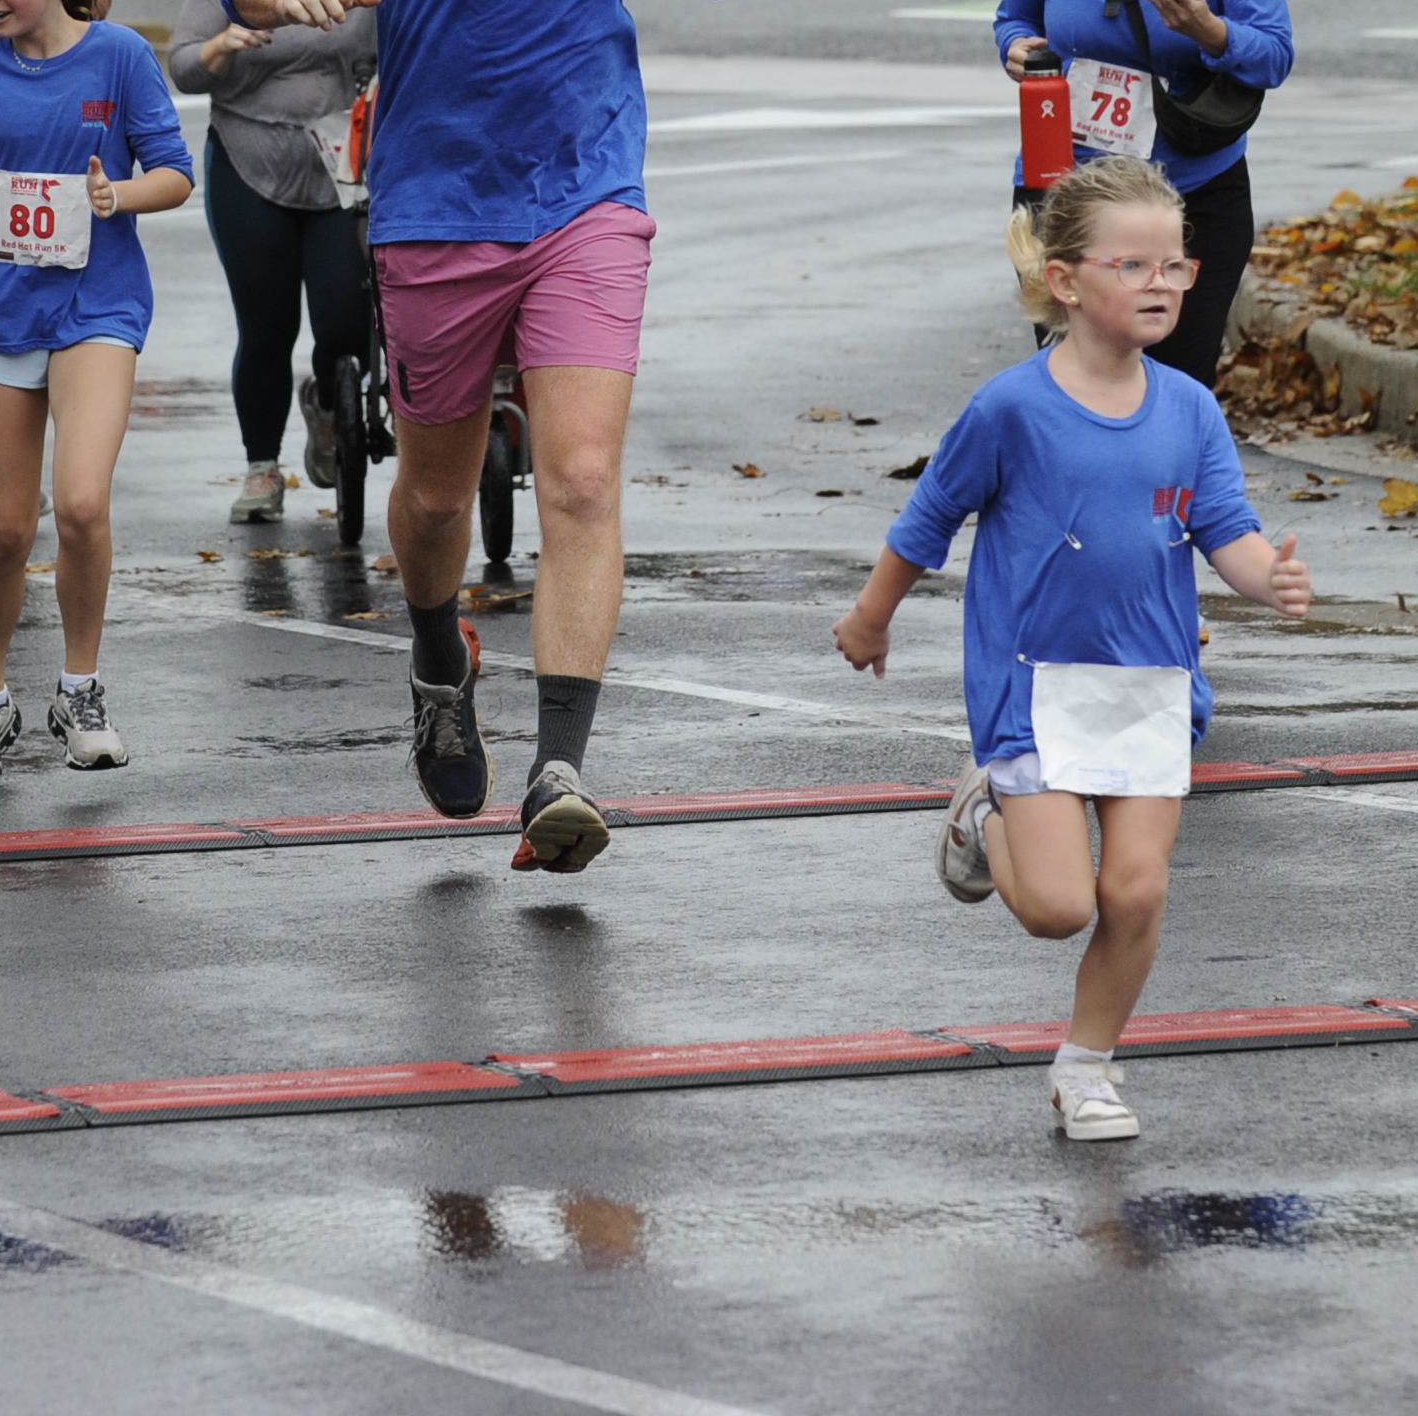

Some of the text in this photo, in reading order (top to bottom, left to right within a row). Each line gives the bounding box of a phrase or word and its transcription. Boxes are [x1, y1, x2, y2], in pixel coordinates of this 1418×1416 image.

[1089, 90, 1132, 127] 78
[11, 180, 38, 190] RUN
[9, 204, 55, 239] 80
[1, 239, 67, 252] Red Hot Run 5K
